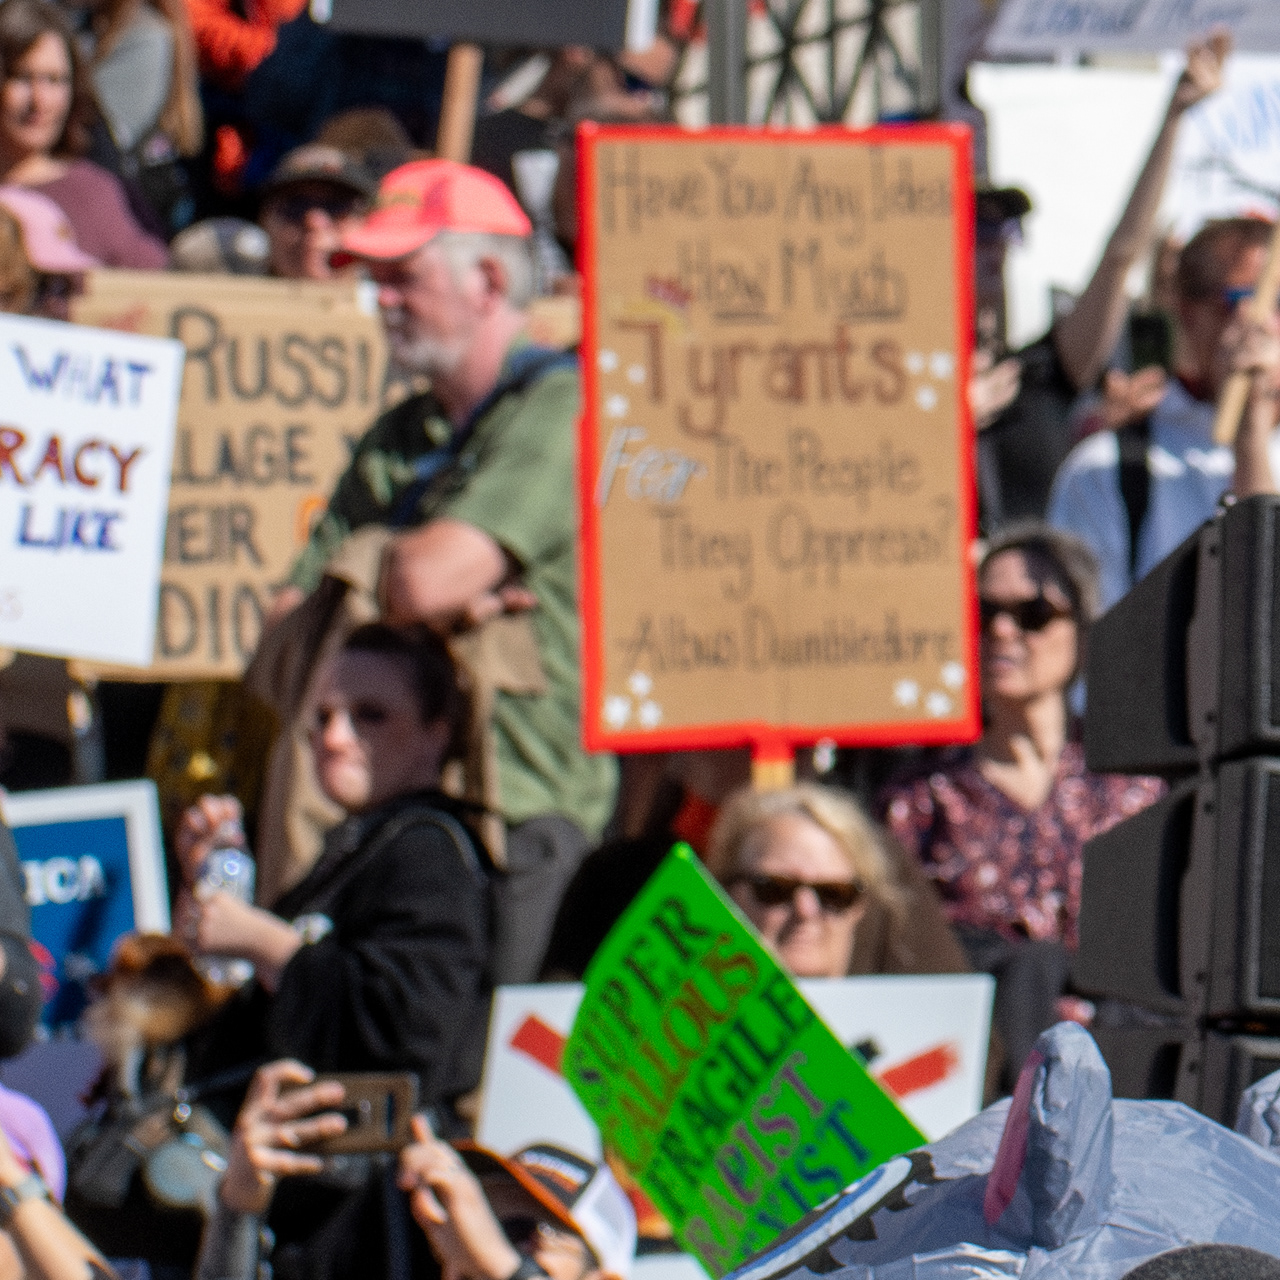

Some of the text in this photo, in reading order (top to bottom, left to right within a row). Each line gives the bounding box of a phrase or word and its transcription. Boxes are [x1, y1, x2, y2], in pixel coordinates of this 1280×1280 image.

[10, 342, 156, 408] WHAT
[167, 304, 374, 410] RUSSI
[612, 320, 908, 441] Tyrants
[174, 424, 317, 488] LAGE
[168, 503, 266, 568] EIR
[571, 892, 711, 1108] SUPER
[648, 972, 818, 1219] FRAGILE
